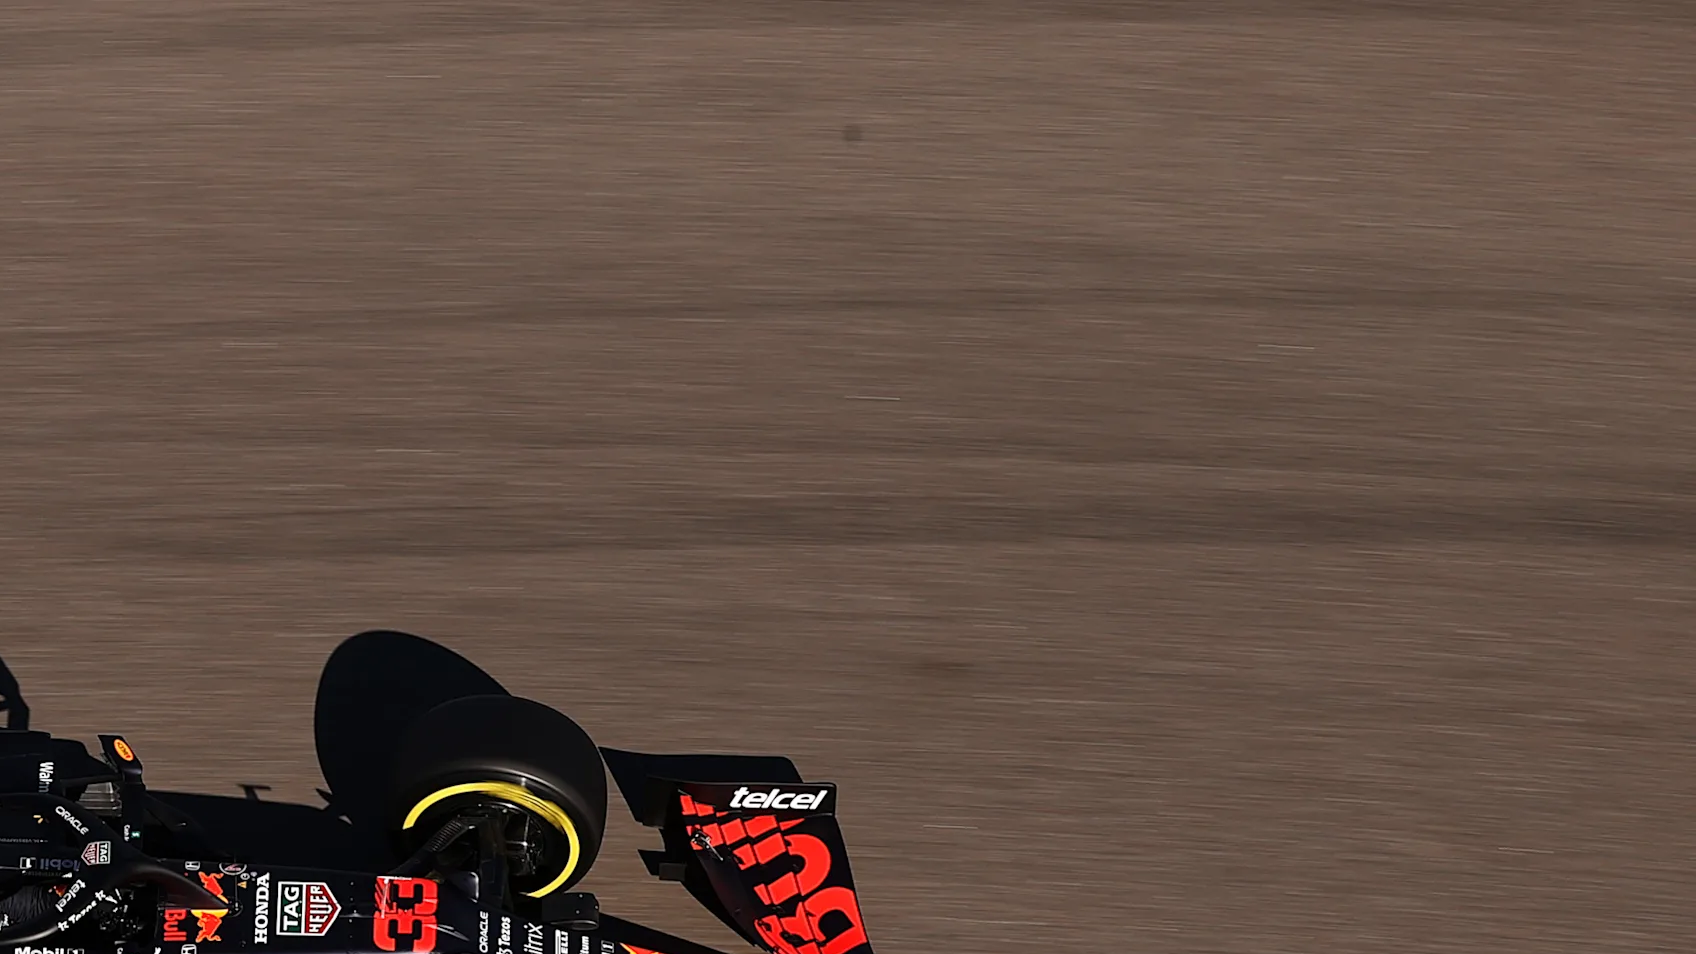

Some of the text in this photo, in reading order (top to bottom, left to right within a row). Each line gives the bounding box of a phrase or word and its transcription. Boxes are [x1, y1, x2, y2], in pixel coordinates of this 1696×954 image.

[729, 786, 828, 811] telcel
[54, 805, 90, 836] ORACLE
[98, 843, 109, 863] TAG
[55, 878, 87, 913] telcel
[254, 871, 272, 945] HONDA
[282, 885, 325, 934] TAG HEUER
[163, 908, 188, 942] Bull
[372, 875, 440, 953] 33
[498, 916, 512, 946] Tezos
[478, 910, 490, 954] ORACLE
